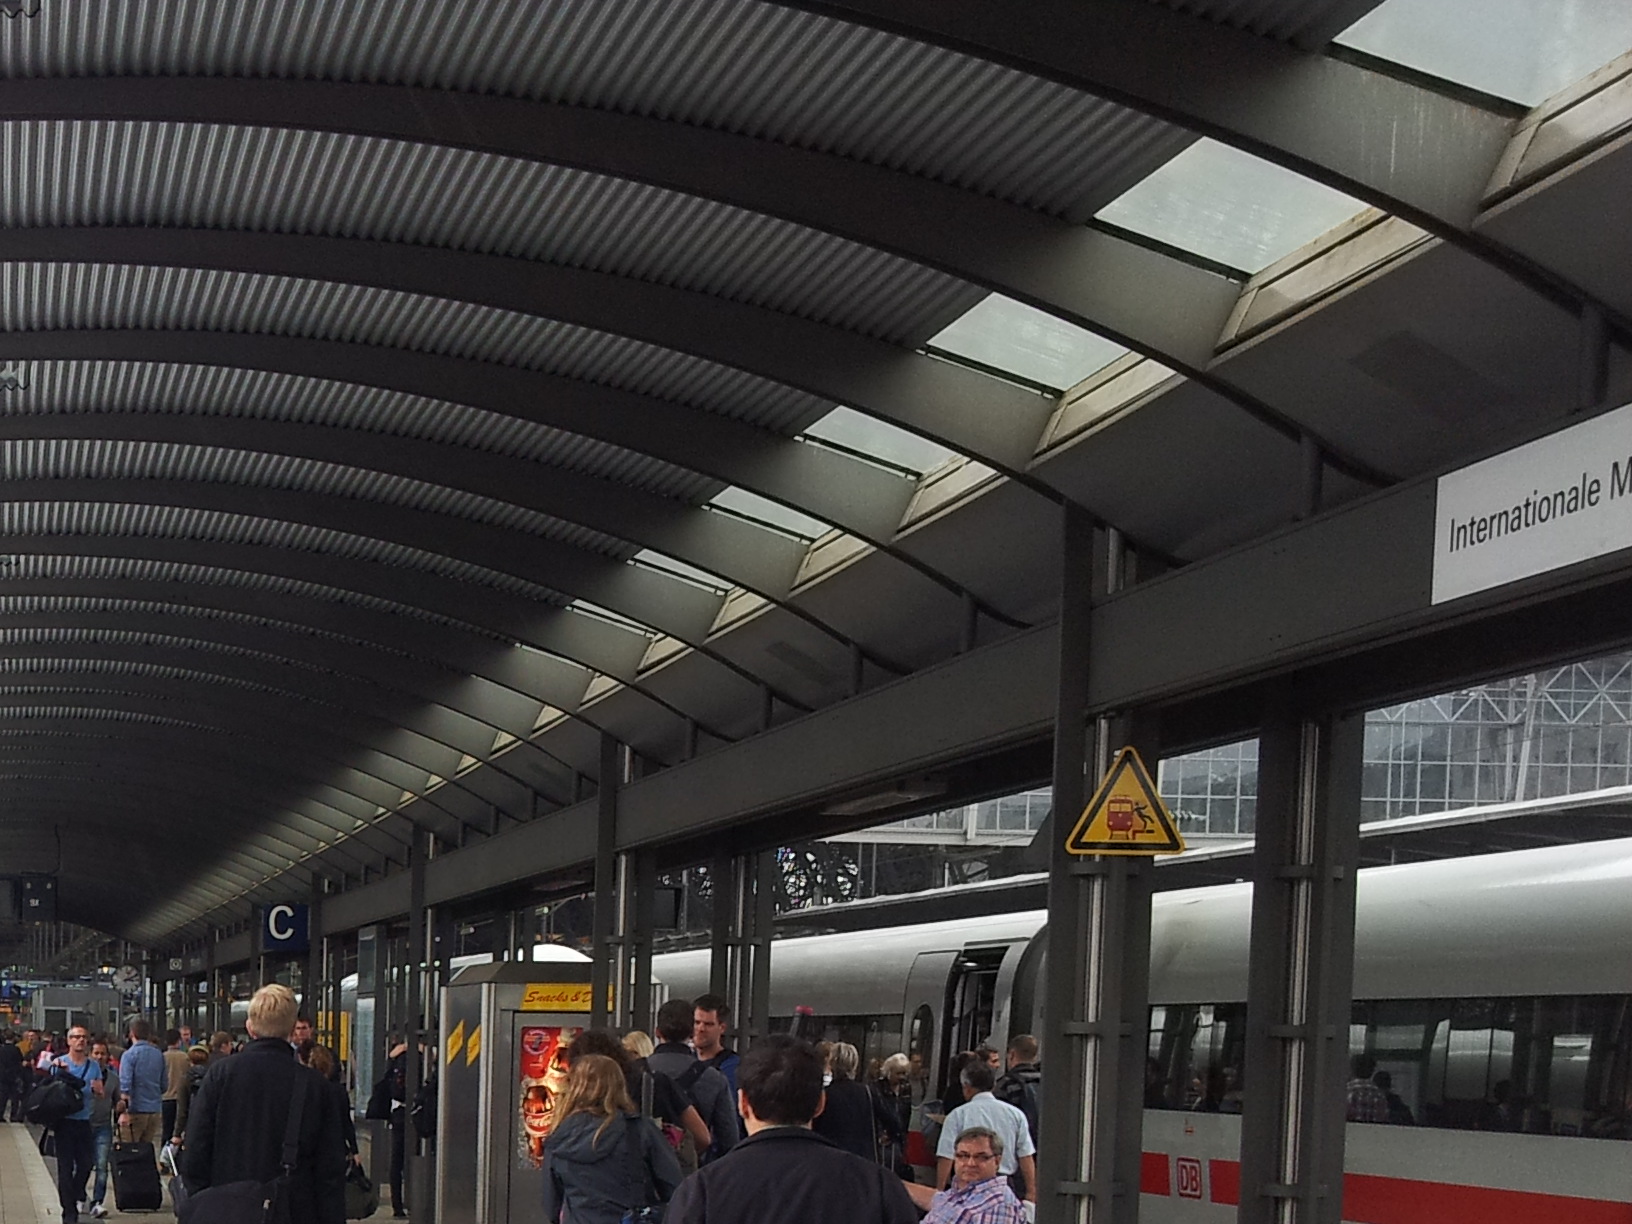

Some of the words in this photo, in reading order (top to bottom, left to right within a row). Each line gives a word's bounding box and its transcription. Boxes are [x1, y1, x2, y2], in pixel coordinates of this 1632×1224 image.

[1448, 471, 1601, 553] Internationale
[269, 905, 294, 940] C
[524, 991, 569, 1003] Snacks
[1180, 1164, 1198, 1192] DB
